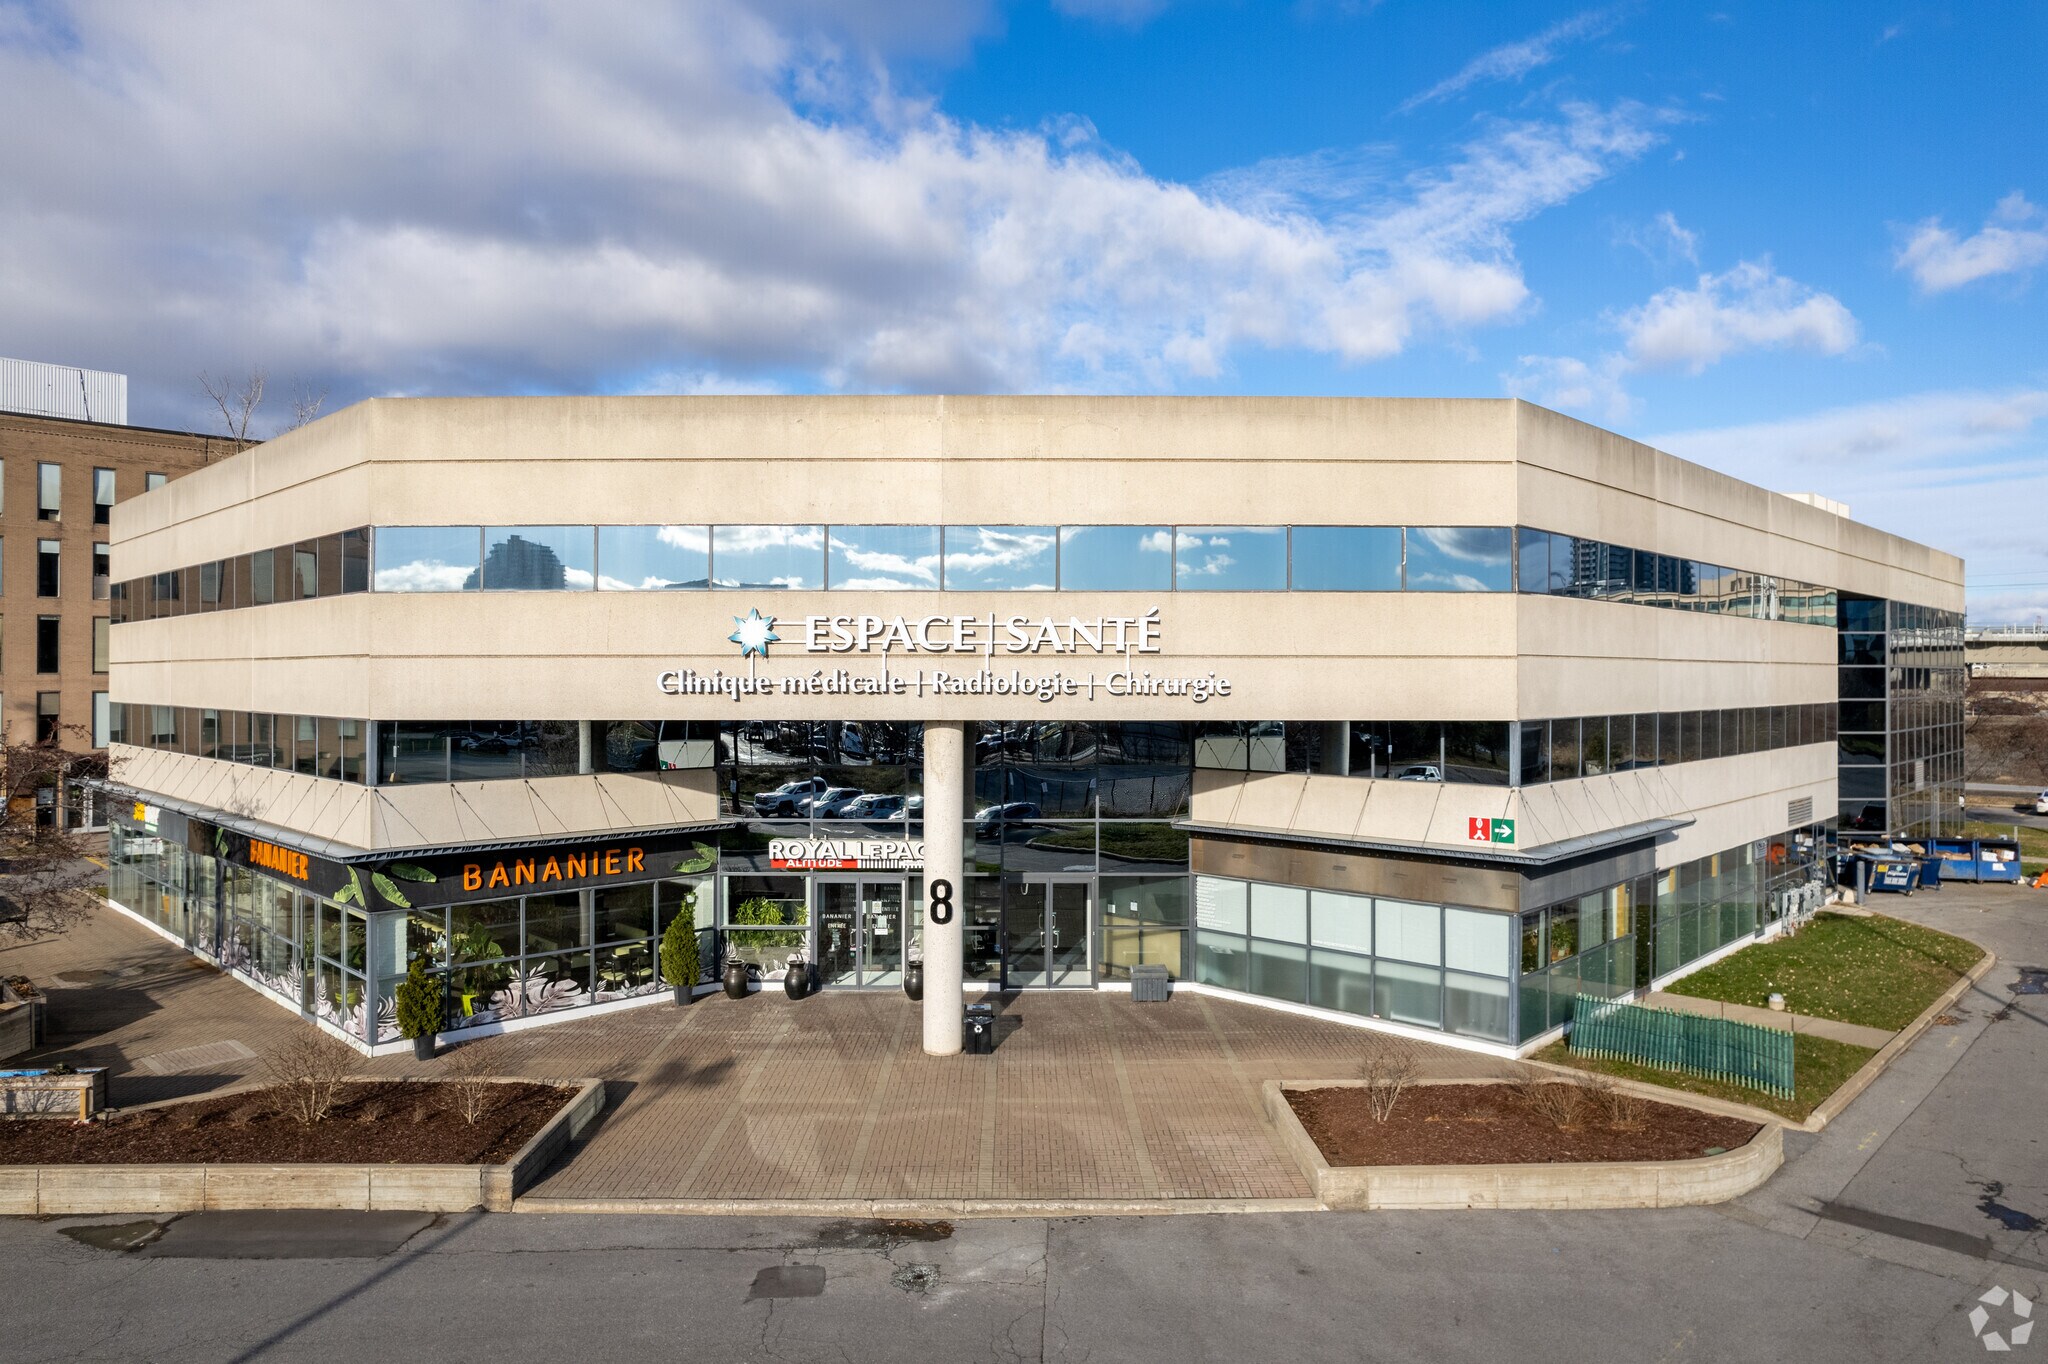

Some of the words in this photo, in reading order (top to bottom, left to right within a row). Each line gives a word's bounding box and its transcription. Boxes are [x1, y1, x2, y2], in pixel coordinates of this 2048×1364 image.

[805, 615, 976, 652] ESPACE
[1006, 605, 1161, 652] SANTÉ
[656, 668, 772, 700] Clinique
[780, 669, 906, 693] médicale
[932, 669, 1077, 701] Radiologie
[1105, 670, 1232, 702] Chirurgie
[250, 838, 309, 881] BANANIER
[463, 847, 645, 892] BANANIER
[769, 841, 852, 860] ROYAL
[856, 841, 924, 860] LEPA
[785, 859, 843, 868] ALTITUDE
[930, 878, 953, 925] 8
